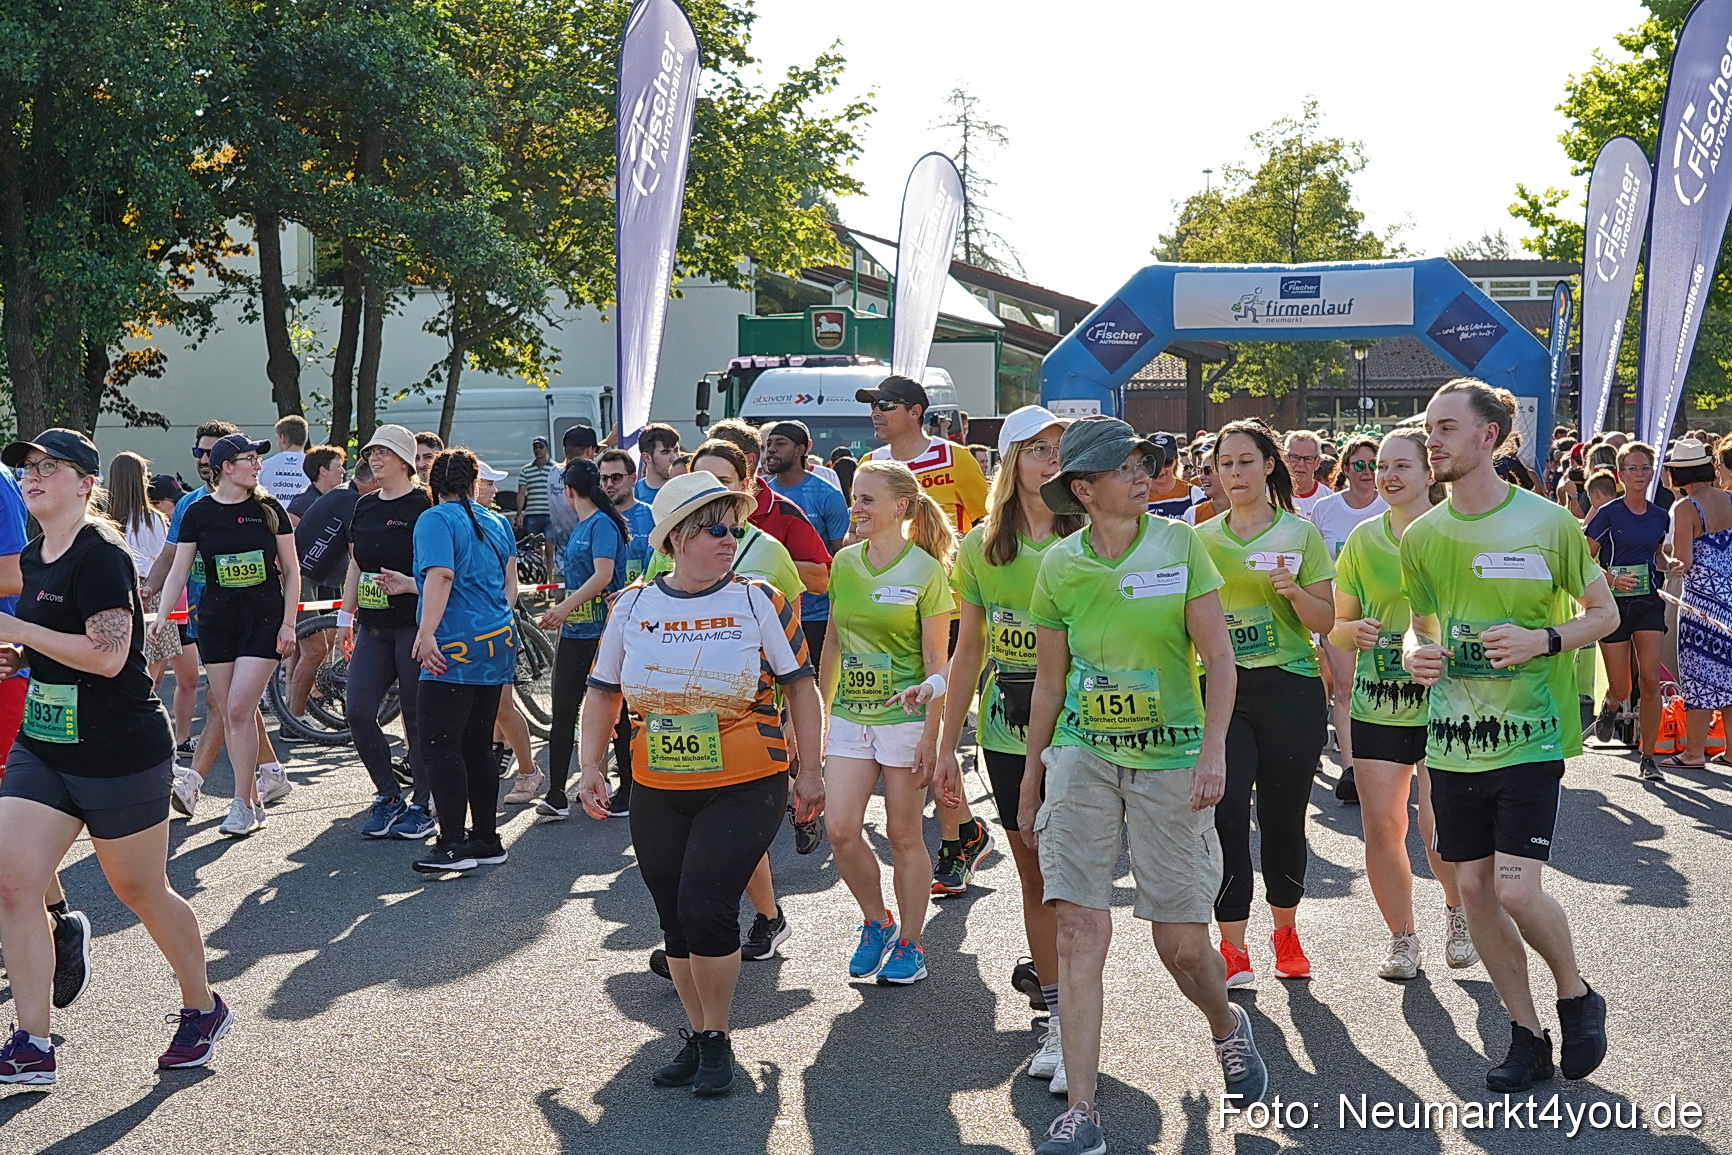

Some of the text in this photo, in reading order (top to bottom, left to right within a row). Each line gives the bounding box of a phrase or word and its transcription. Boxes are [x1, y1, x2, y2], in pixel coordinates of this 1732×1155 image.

[641, 31, 678, 170] Fischer
[660, 51, 684, 164] AUTOMOBILE
[1604, 162, 1634, 263] Fischer
[1619, 176, 1642, 259] AUTOMOBILE
[920, 179, 946, 283] Fischer
[1266, 298, 1355, 316] firmenlauf
[1095, 329, 1143, 340] Fischer
[752, 395, 793, 404] abavent
[918, 472, 955, 489] ÖGL
[194, 561, 205, 572] 19
[224, 563, 258, 577] 1939
[1156, 571, 1180, 579] Klinikum
[43, 592, 64, 602] ECOVIS
[361, 584, 382, 598] 1940
[664, 616, 742, 631] KLEBL
[661, 630, 743, 643] DYNAMICS
[999, 628, 1037, 650] 400
[1265, 624, 1276, 647] 2022
[995, 645, 1018, 657] Bergler
[1460, 641, 1491, 662] 18
[1377, 654, 1386, 672] RUN
[1455, 660, 1485, 671] Rothkegel
[848, 670, 876, 688] 399
[882, 673, 890, 696] 2022
[29, 699, 64, 724] 1937
[1081, 695, 1090, 726] WALK
[1095, 693, 1136, 716] 151
[1147, 696, 1159, 724] 2022
[65, 708, 75, 736] 2022
[1089, 715, 1150, 723] Borchert Christine
[649, 736, 658, 764] WALK
[661, 734, 700, 755] 546
[708, 736, 718, 763] 2022
[681, 754, 711, 762] Michaela
